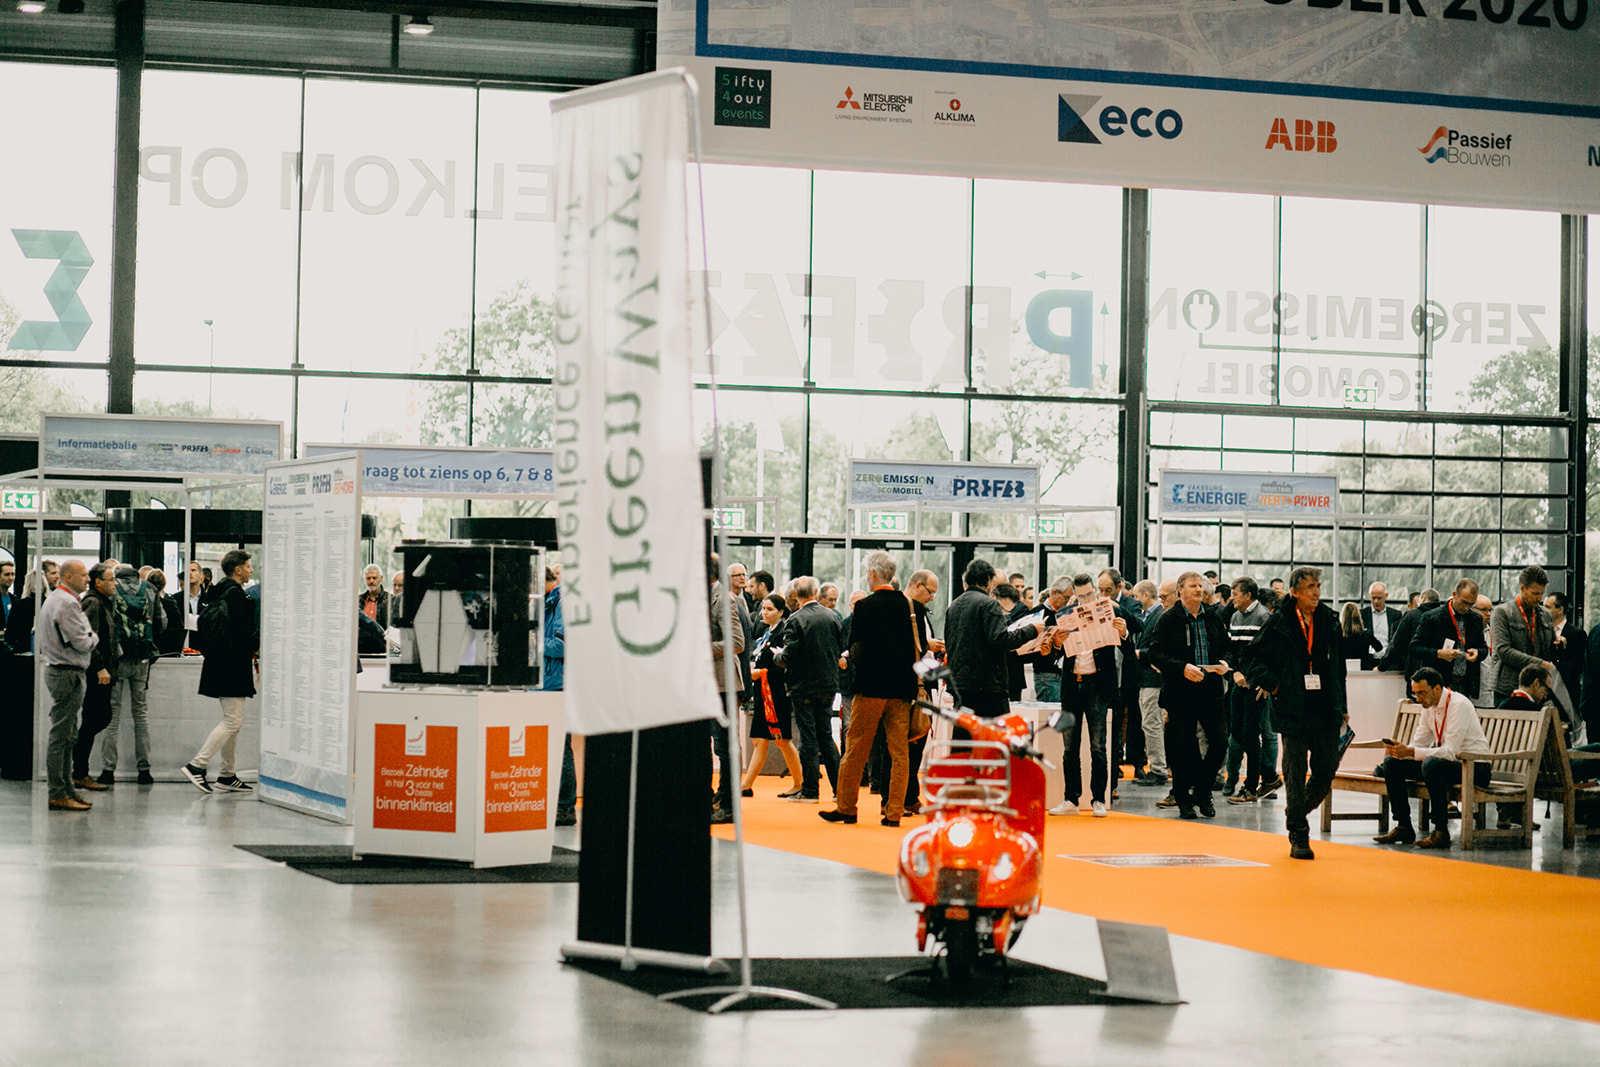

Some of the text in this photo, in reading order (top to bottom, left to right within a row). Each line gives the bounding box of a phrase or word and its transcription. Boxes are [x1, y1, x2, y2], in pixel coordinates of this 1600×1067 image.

[863, 93, 913, 104] MITSUBISHI
[722, 109, 764, 119] events
[863, 102, 906, 112] ELECTRIC
[853, 115, 888, 123] ENVIRONMENT
[934, 112, 976, 123] ALKLIMA
[1265, 118, 1338, 153] ABB
[1447, 129, 1512, 150] Passief
[1447, 147, 1511, 167] Bouwen
[58, 439, 137, 450] Informatiebalie
[362, 465, 553, 483] raag tot ziens op 6, 7 & 8
[878, 486, 923, 495] ECOMOBIEL
[1187, 491, 1247, 505] ENERGIE
[381, 764, 449, 778] Bezoek Zehnder
[509, 765, 542, 778] Zehnder
[386, 779, 392, 787] in
[393, 779, 404, 788] hal
[405, 780, 414, 796] 3
[433, 780, 444, 789] het
[493, 782, 499, 790] in
[509, 781, 517, 797] 3
[376, 796, 453, 813] binnenklimaat
[487, 798, 545, 813] binnenklimaat
